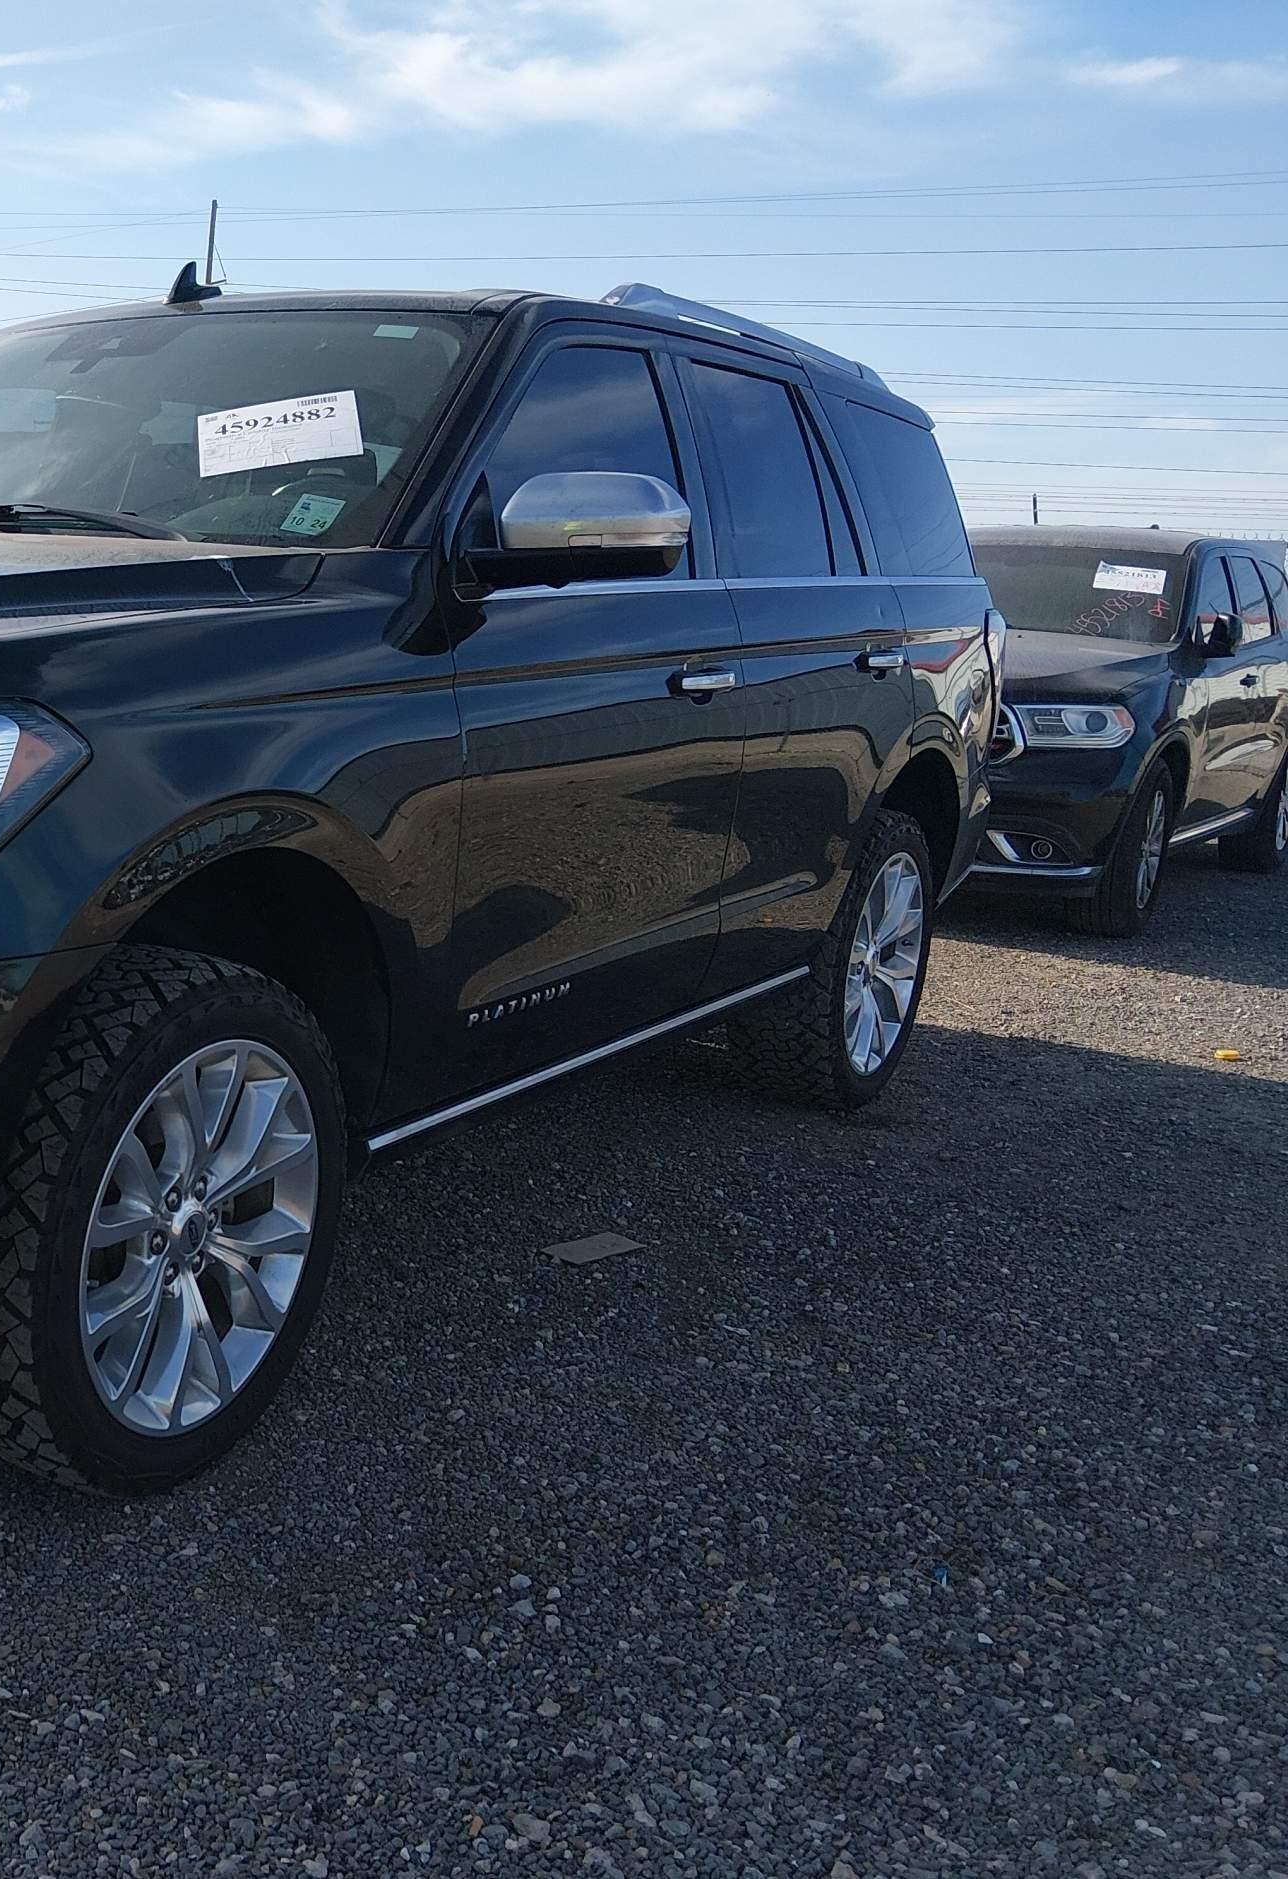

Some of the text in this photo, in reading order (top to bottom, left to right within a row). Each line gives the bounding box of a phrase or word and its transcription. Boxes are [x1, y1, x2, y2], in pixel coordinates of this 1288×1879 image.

[214, 406, 337, 435] 45924882
[290, 516, 327, 530] 10 24
[467, 982, 571, 1028] PLATINUM
